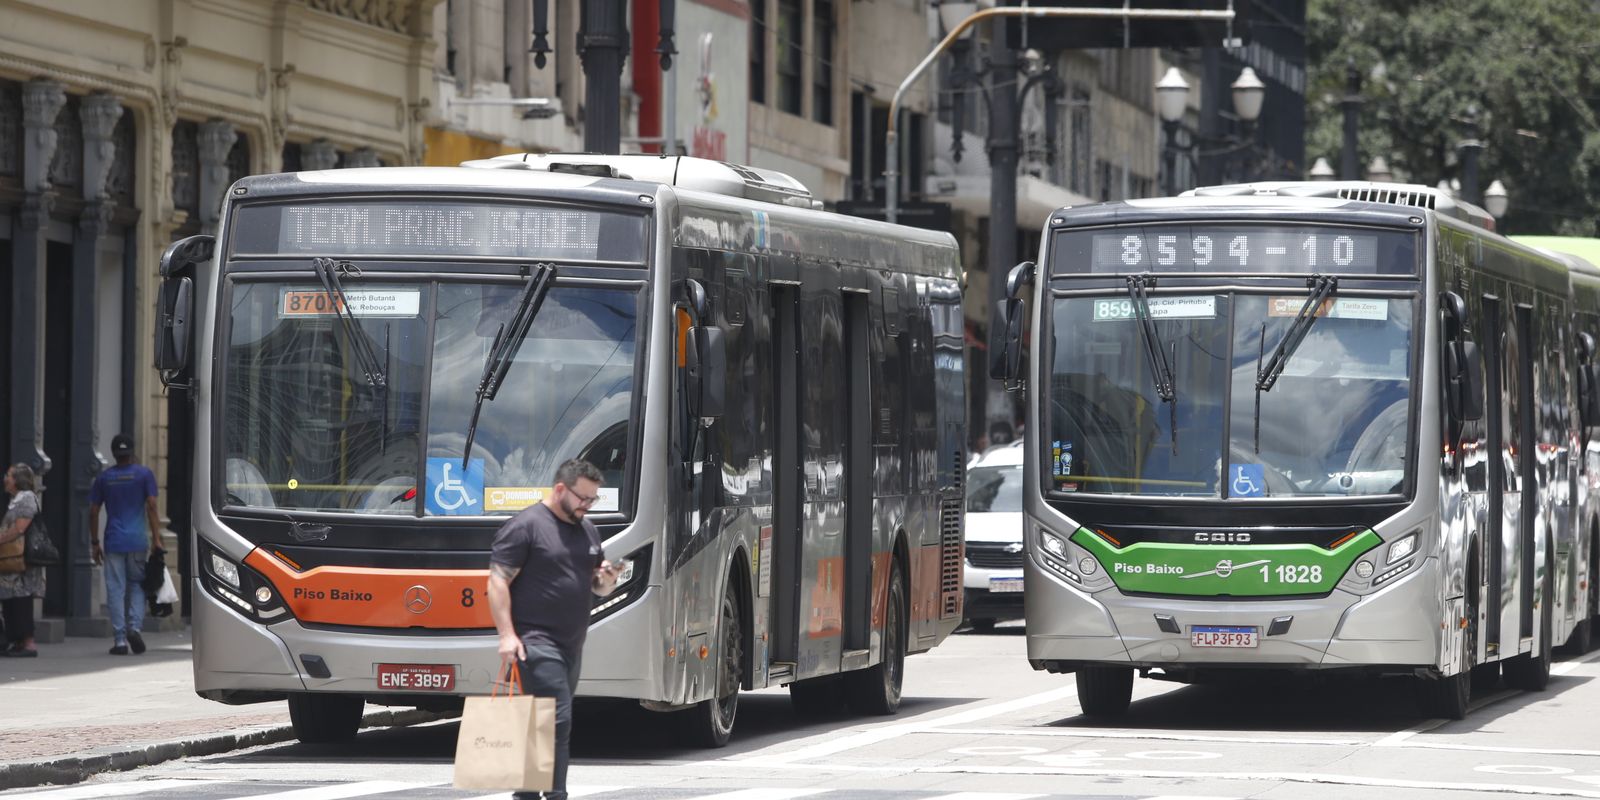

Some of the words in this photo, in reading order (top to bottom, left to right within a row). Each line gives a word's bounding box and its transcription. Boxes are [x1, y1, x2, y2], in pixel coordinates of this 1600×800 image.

[289, 207, 376, 245] TERM.
[385, 209, 481, 247] PRINC.
[490, 211, 598, 249] ISABEL
[1121, 235, 1354, 266] 8594-10
[360, 304, 396, 312] Rebouças
[1194, 532, 1251, 542] CAIO
[1114, 563, 1142, 574] Piso
[1146, 563, 1184, 575] Baixo
[1275, 565, 1323, 584] 1828
[293, 587, 325, 600] Piso
[330, 589, 373, 602] Baixo
[461, 587, 474, 608] 8
